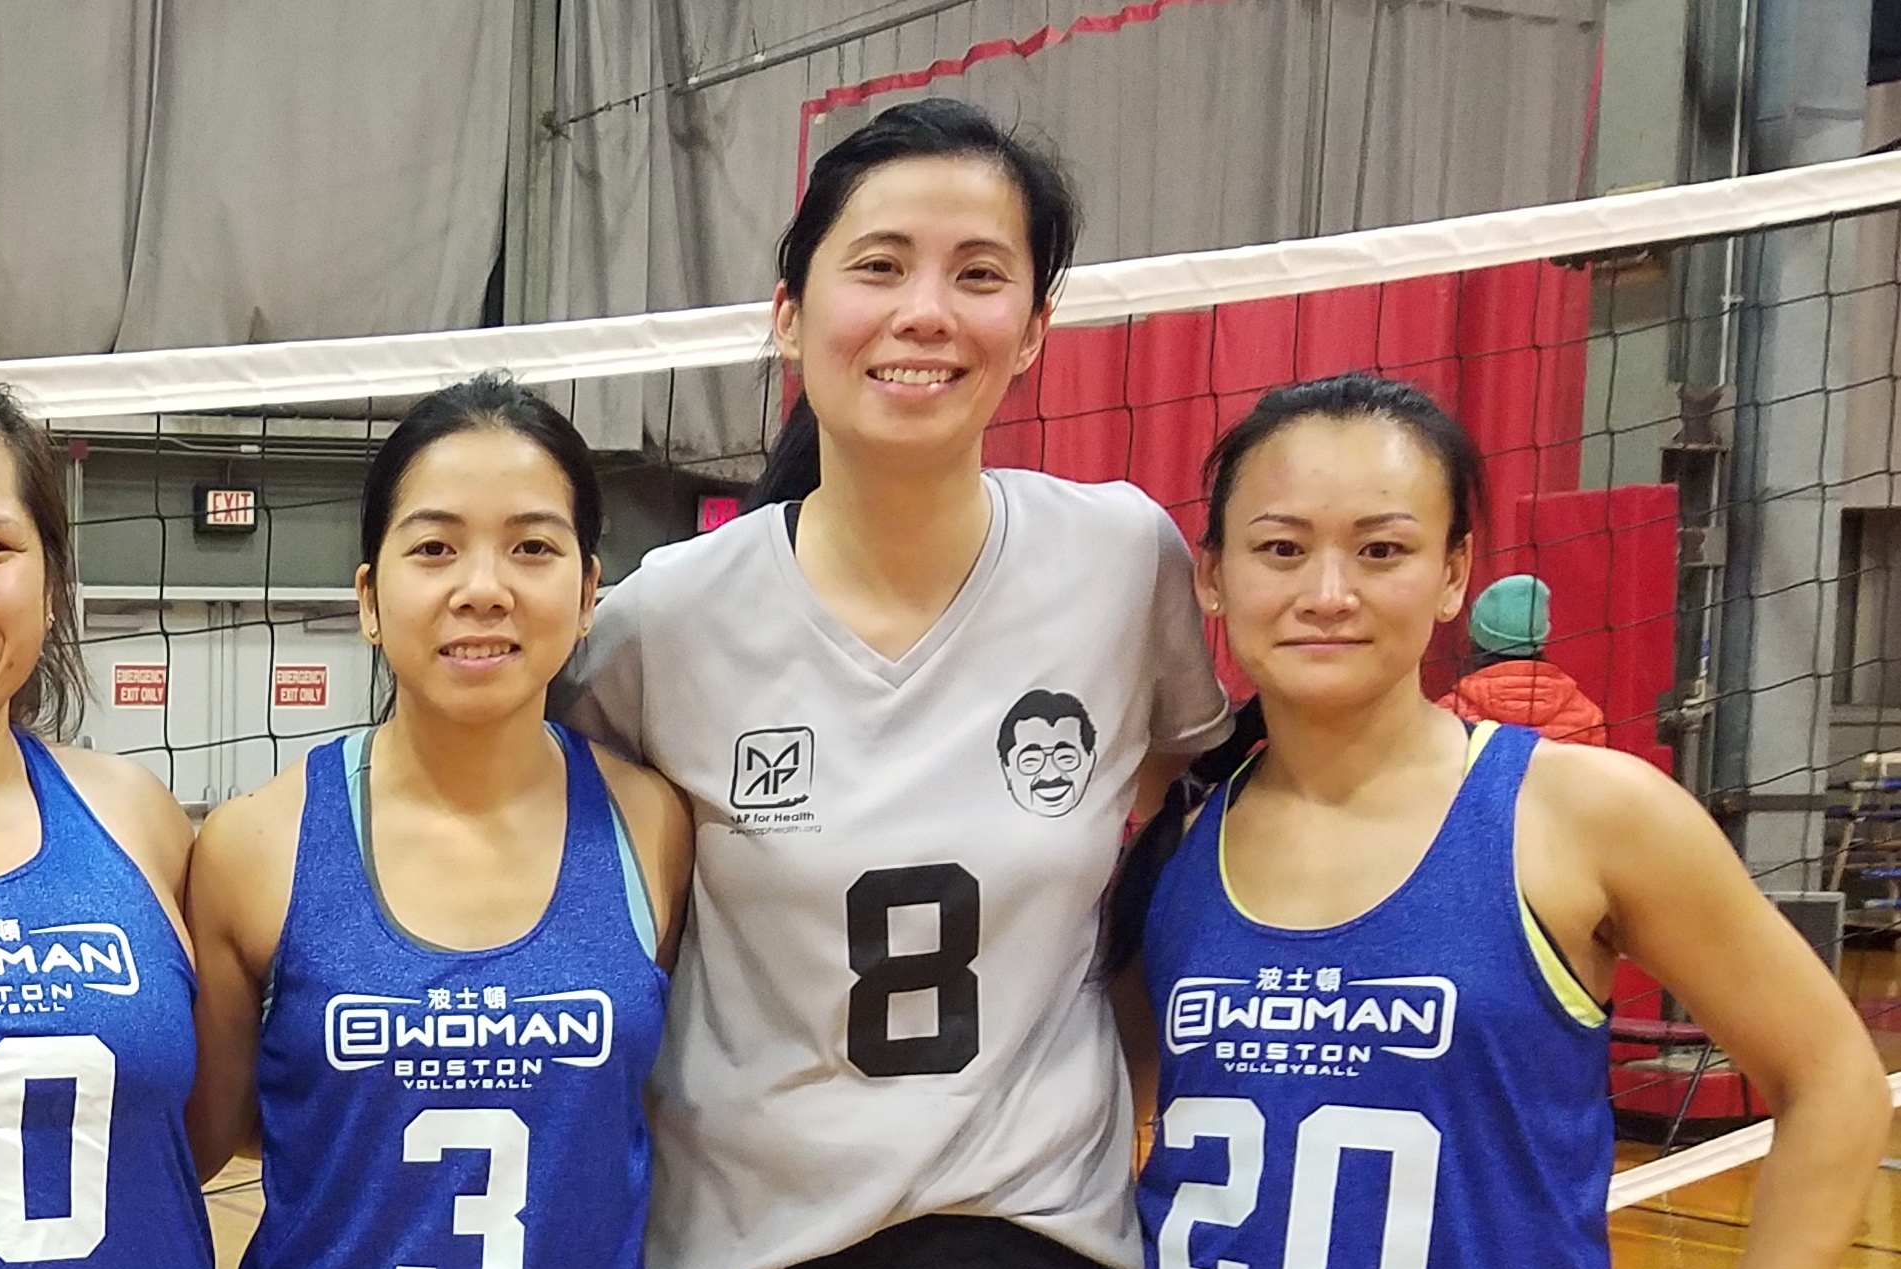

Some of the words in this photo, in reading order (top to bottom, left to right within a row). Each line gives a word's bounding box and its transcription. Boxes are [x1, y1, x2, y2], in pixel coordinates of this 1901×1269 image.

[212, 492, 252, 523] EXIT
[116, 669, 166, 684] EMERGENCY
[276, 670, 325, 684] EMERGENCY
[120, 686, 140, 702] EXIT
[141, 687, 164, 702] ONLY
[280, 687, 299, 702] EXIT
[300, 687, 322, 702] ONLY
[753, 813, 771, 823] for
[773, 811, 815, 823] Health
[845, 861, 981, 1077] 8
[1255, 966, 1344, 993] 波士頓
[427, 986, 507, 1010] 波士頓
[1214, 1041, 1372, 1064] BOSTON
[393, 1058, 542, 1077] BOSTON
[1222, 1062, 1360, 1077] VOLLEYBALL
[402, 1078, 534, 1090] VOLLEYBALL
